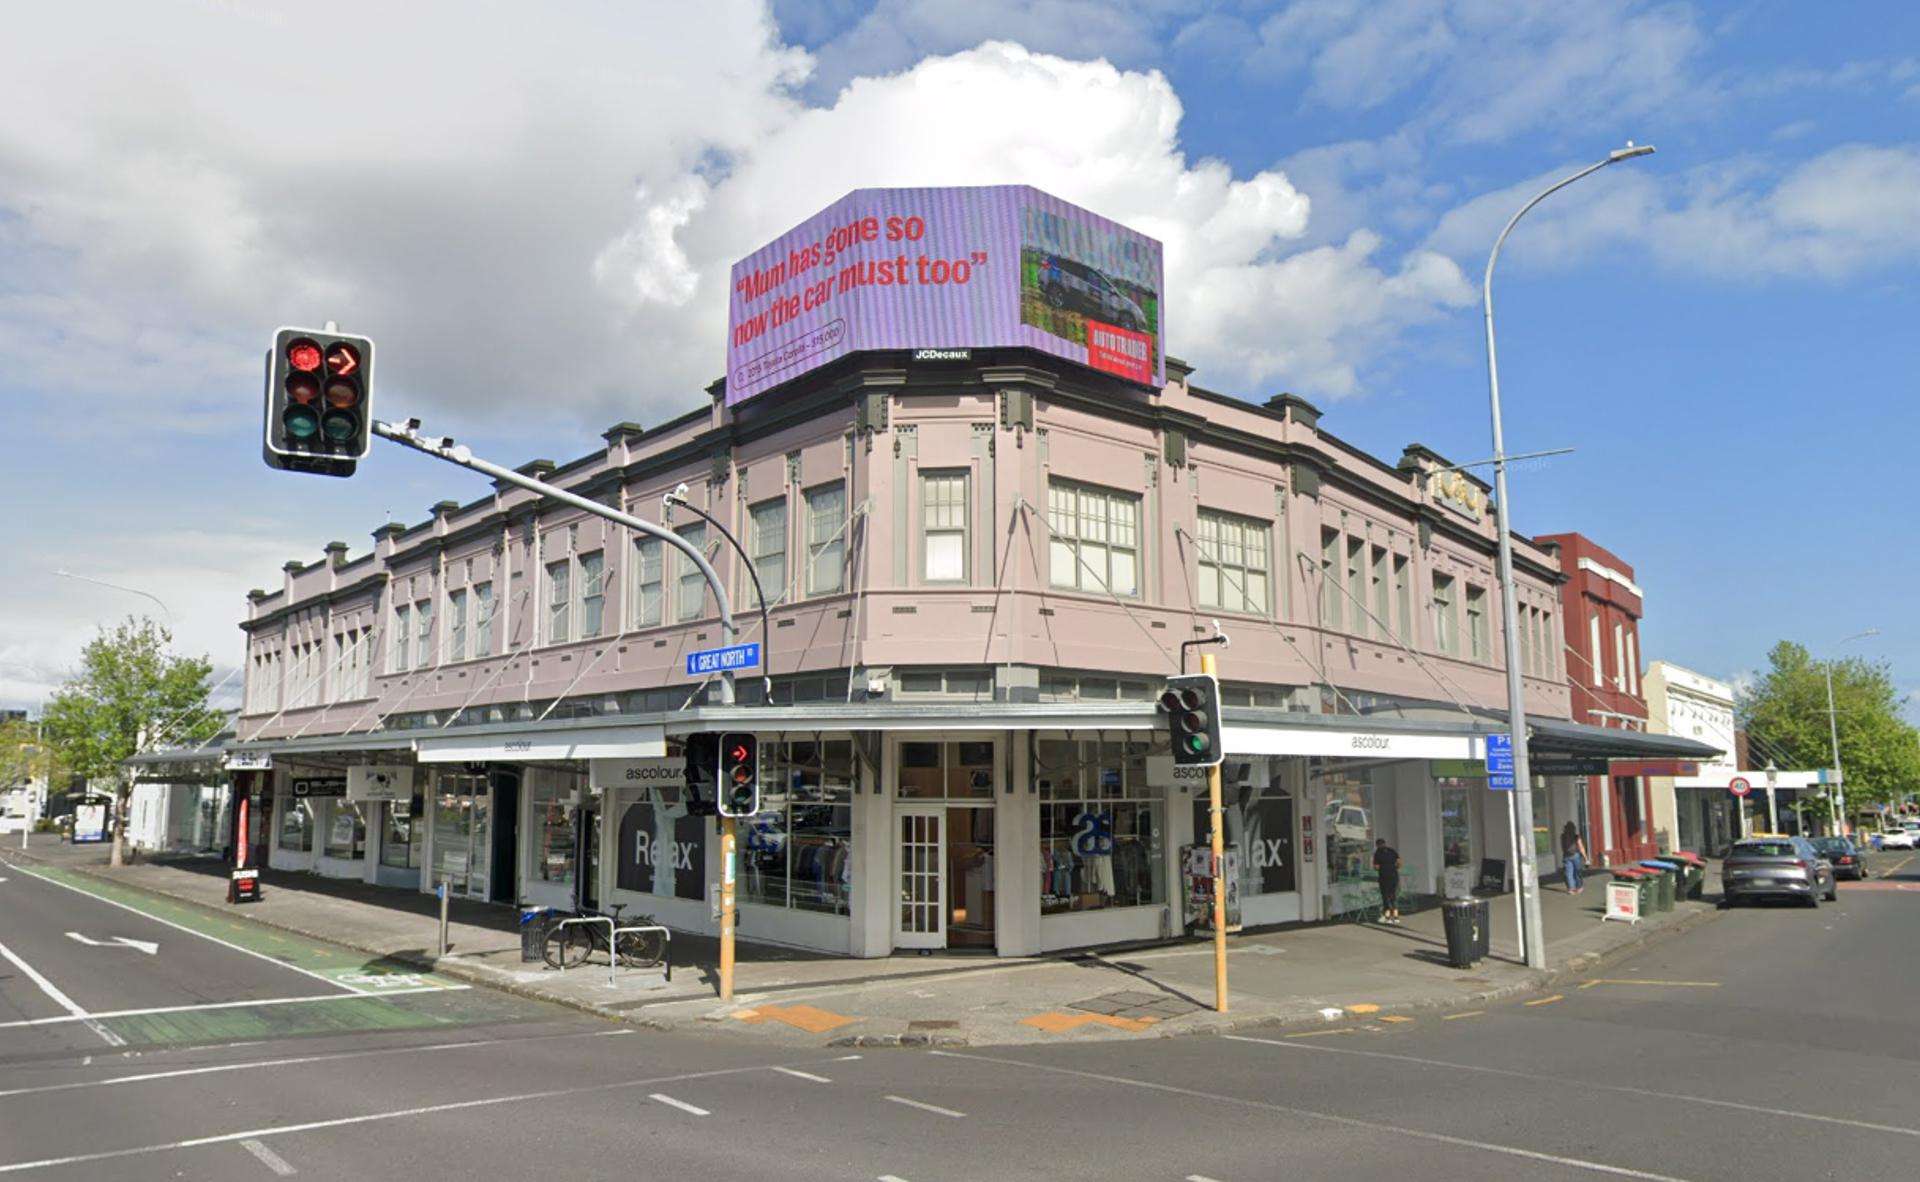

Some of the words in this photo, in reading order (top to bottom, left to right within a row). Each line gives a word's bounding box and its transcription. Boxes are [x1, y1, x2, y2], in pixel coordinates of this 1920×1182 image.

[788, 248, 822, 279] has
[824, 216, 879, 266] gone
[885, 214, 926, 241] so
[733, 311, 769, 348] now
[770, 295, 801, 329] the
[803, 275, 836, 311] car
[838, 255, 909, 294] must
[915, 349, 968, 359] JCDecaux
[699, 652, 720, 672] GREAT
[721, 648, 745, 667] NORTH
